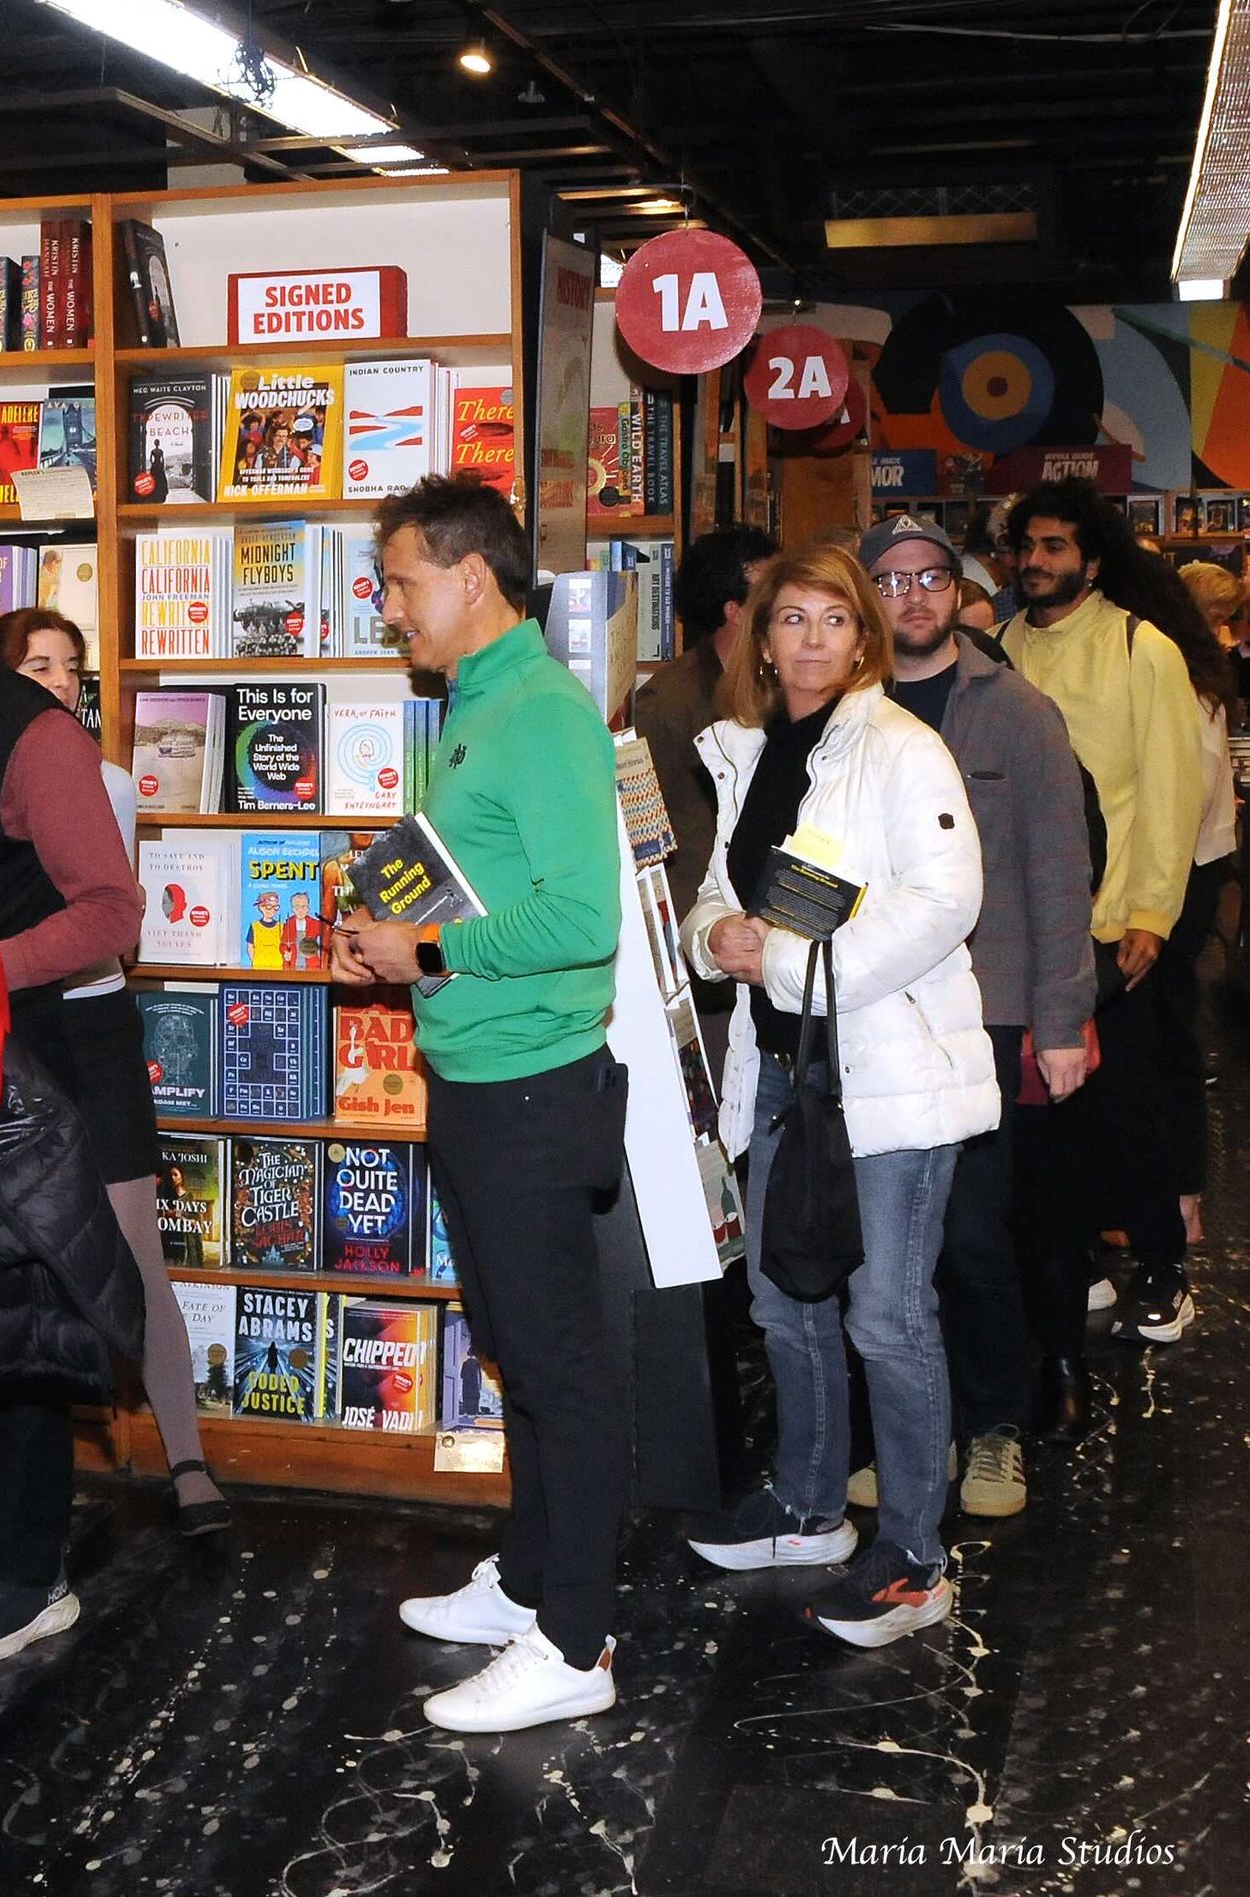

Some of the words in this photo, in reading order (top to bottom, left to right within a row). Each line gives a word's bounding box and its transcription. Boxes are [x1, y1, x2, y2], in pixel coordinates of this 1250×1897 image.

[50, 239, 59, 276] KRISTIN
[71, 237, 79, 274] KRISTIN
[265, 282, 352, 308] SIGNED
[653, 272, 729, 332] 1A
[46, 293, 55, 333] WOMEN
[66, 291, 75, 331] WOMEN
[253, 307, 365, 335] EDITIONS
[349, 368, 379, 376] INDIAN
[383, 365, 424, 374] COUNTRY
[768, 355, 832, 399] 2A
[173, 384, 207, 393] CLAYTON
[258, 374, 315, 390] Little
[235, 389, 335, 410] WOODCHUCKS
[457, 399, 515, 421] There
[149, 427, 190, 437] BEACH
[631, 414, 642, 450] WILD
[456, 442, 515, 464] There
[659, 436, 668, 471] TRAVEL
[631, 456, 643, 503] EARTH
[1042, 460, 1099, 481] ACTION
[223, 485, 248, 497] NICK
[251, 483, 309, 495] OFFERMAN
[348, 485, 383, 493] SHOBHA
[659, 474, 668, 504] ATLAS
[141, 540, 211, 566] CALIFORNIA
[241, 542, 296, 565] MIDNIGHT
[141, 568, 210, 594] CALIFORNIA
[243, 564, 294, 586] FLYBOYS
[141, 629, 210, 655] REWRITTEN
[236, 688, 269, 704] This
[273, 688, 286, 703] Is
[290, 687, 314, 704] for
[238, 706, 312, 724] Everyone
[255, 742, 298, 752] Unfinished
[268, 734, 284, 742] The
[253, 753, 275, 765] Story
[276, 753, 285, 762] of
[285, 753, 300, 762] the
[253, 763, 277, 771] World
[278, 762, 300, 771] Wide
[266, 772, 287, 781] Web
[238, 799, 255, 811] Tim
[257, 800, 316, 811] Berners-Lee
[249, 860, 319, 881] SPENT
[380, 858, 404, 880] The
[379, 862, 426, 904] Running
[391, 876, 432, 915] Ground
[340, 1015, 414, 1042] BAD
[338, 1041, 416, 1071] GIRL
[338, 1096, 379, 1112] Gish
[384, 1098, 415, 1116] Jen
[179, 1152, 207, 1164] JOSHI
[259, 1152, 281, 1166] THE
[345, 1147, 391, 1168] NOT
[238, 1165, 306, 1186] MAGICIAN
[263, 1179, 277, 1189] OF
[336, 1169, 398, 1191] QUITE
[172, 1199, 207, 1213] DAYS
[250, 1187, 292, 1207] TIGER
[339, 1191, 396, 1213] DEAD
[157, 1216, 213, 1234] OMBAY
[241, 1200, 299, 1228] CASTLE
[348, 1213, 386, 1235] YET
[344, 1245, 390, 1259] HOLLY
[335, 1259, 401, 1273] JACKSON
[182, 1301, 208, 1310] FATE
[211, 1303, 226, 1313] OF
[243, 1293, 309, 1319] STACEY
[192, 1313, 215, 1323] DAY
[238, 1315, 313, 1342] ABRAMS
[343, 1338, 418, 1367] CHIPPED
[248, 1371, 299, 1393] CODED
[241, 1391, 306, 1415] JUSTICE
[342, 1405, 375, 1429] JOSÉ
